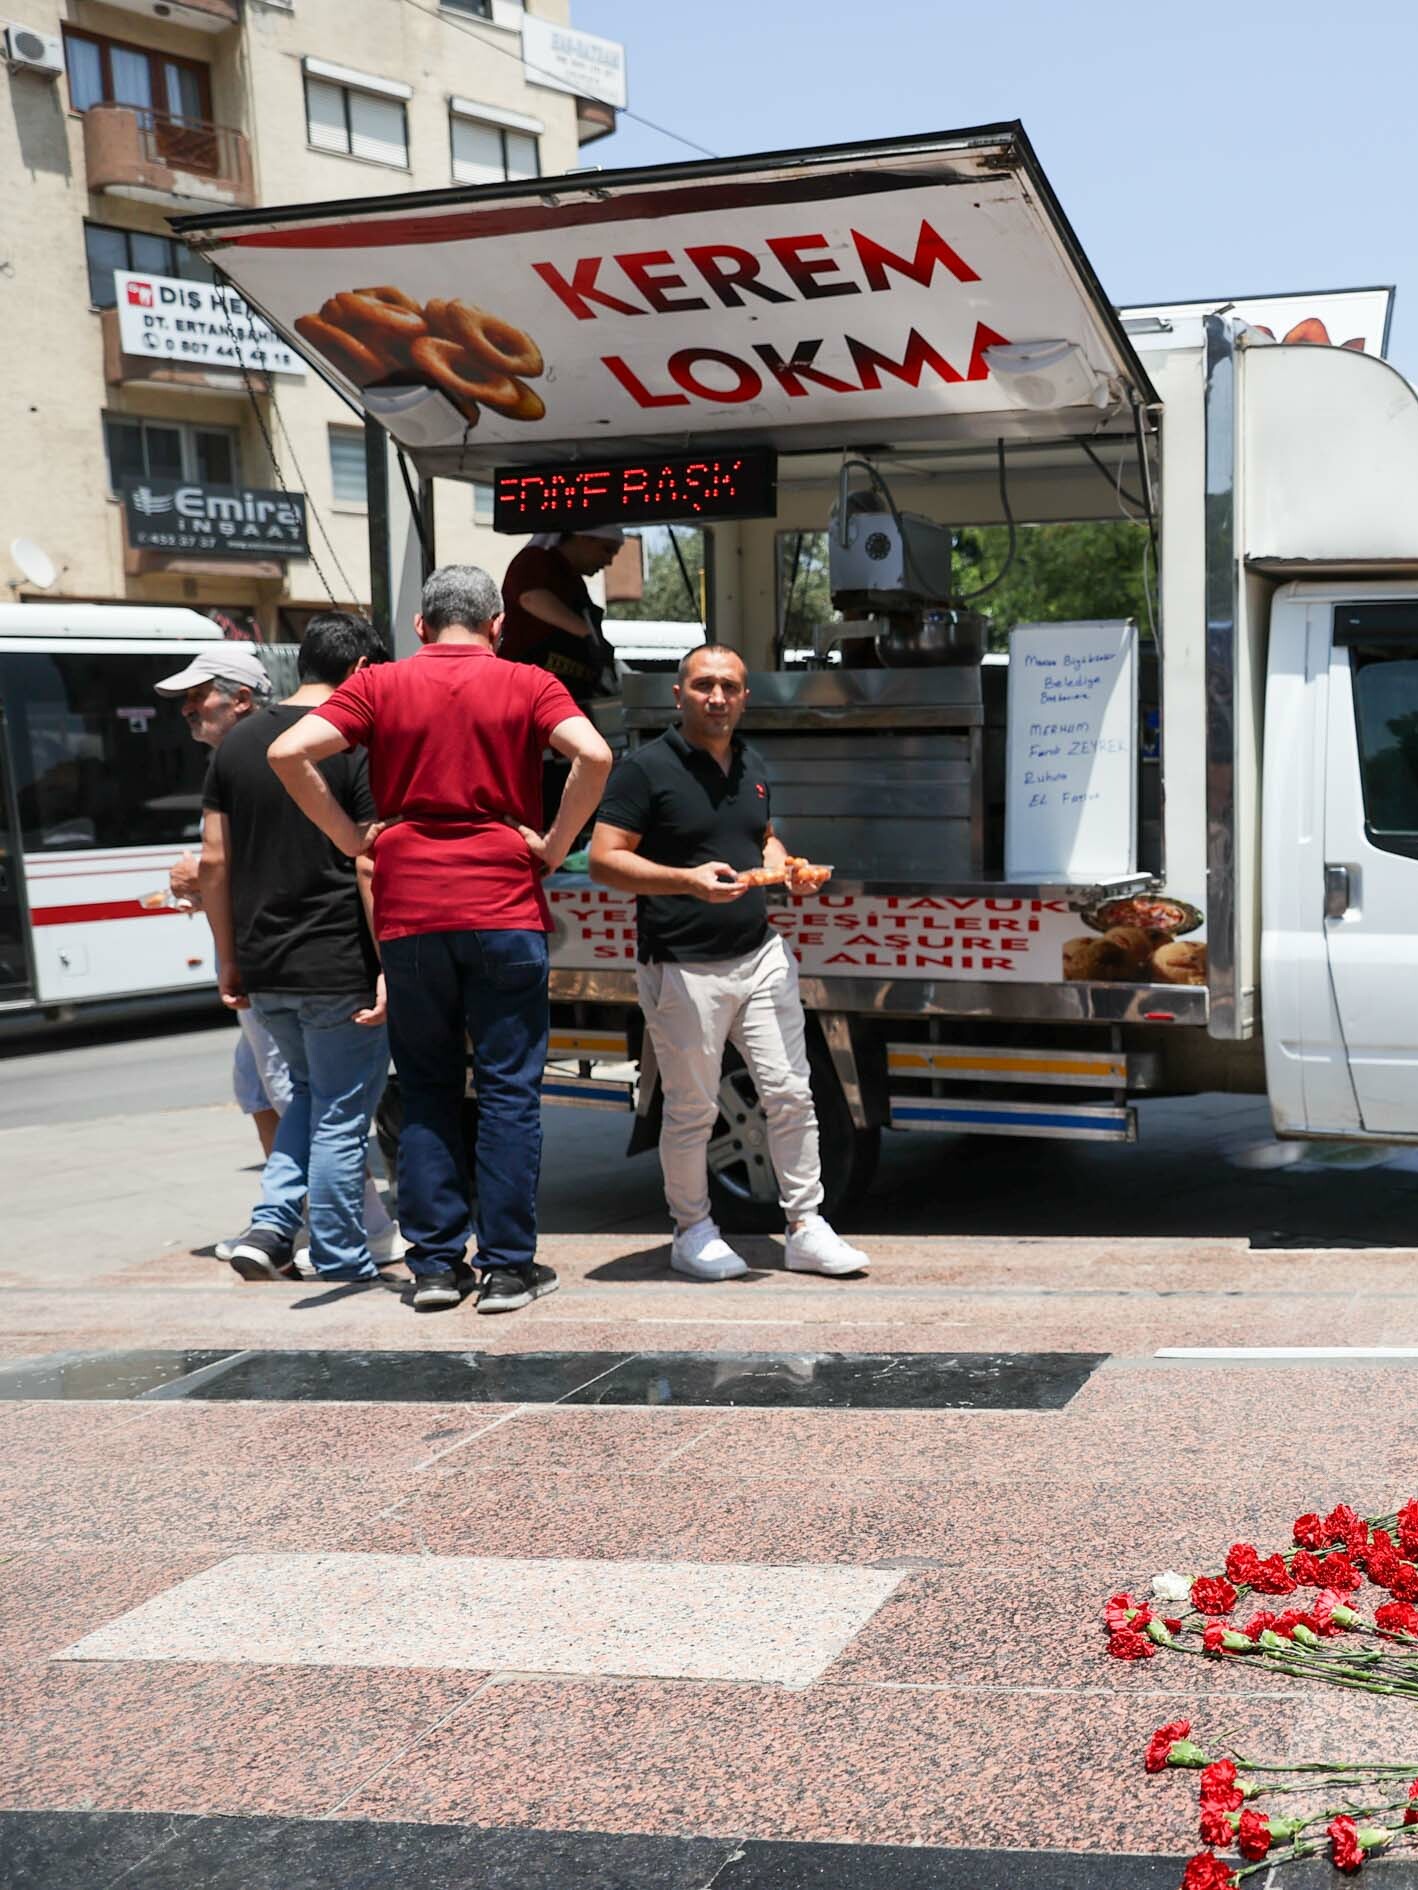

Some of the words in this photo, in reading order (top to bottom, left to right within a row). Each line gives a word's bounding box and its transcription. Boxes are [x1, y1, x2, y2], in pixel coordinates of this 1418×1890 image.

[531, 219, 982, 320] KEREM
[160, 285, 202, 310] DİŞ
[600, 320, 1012, 408] LOKMA
[767, 911, 1040, 932] ÇEŞİTLERİ
[844, 934, 1030, 952] AŞURE
